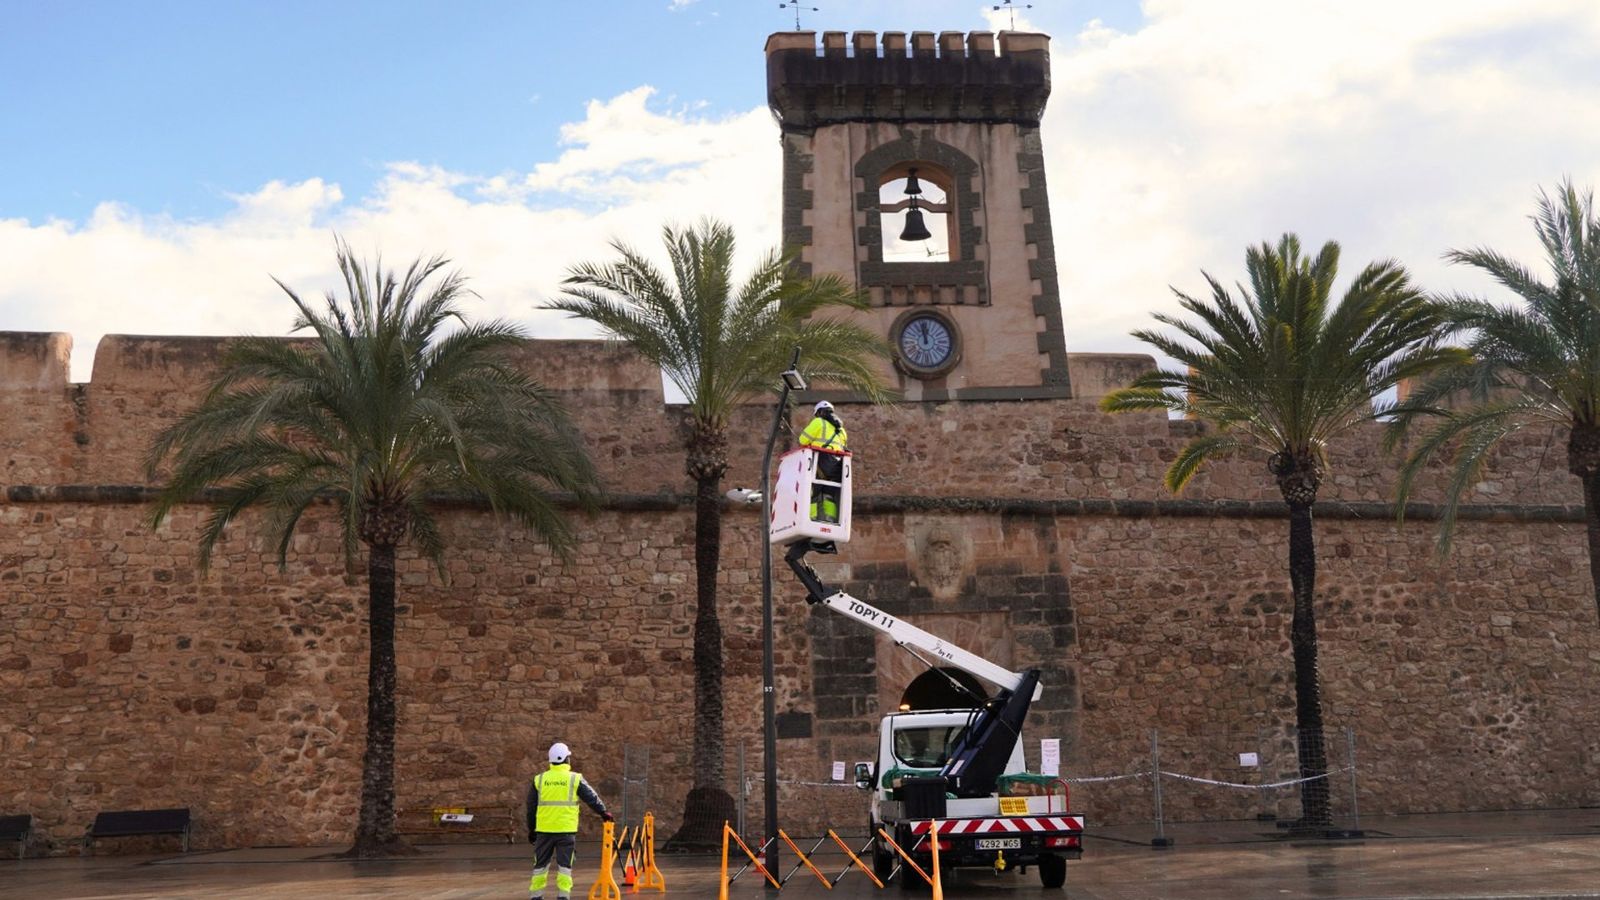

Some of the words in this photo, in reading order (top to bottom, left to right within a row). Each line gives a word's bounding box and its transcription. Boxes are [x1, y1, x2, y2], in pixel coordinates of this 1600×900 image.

[848, 601, 879, 620] TOPY
[880, 616, 894, 628] 11
[980, 840, 1000, 849] 4292
[1003, 839, 1019, 848] MGS
